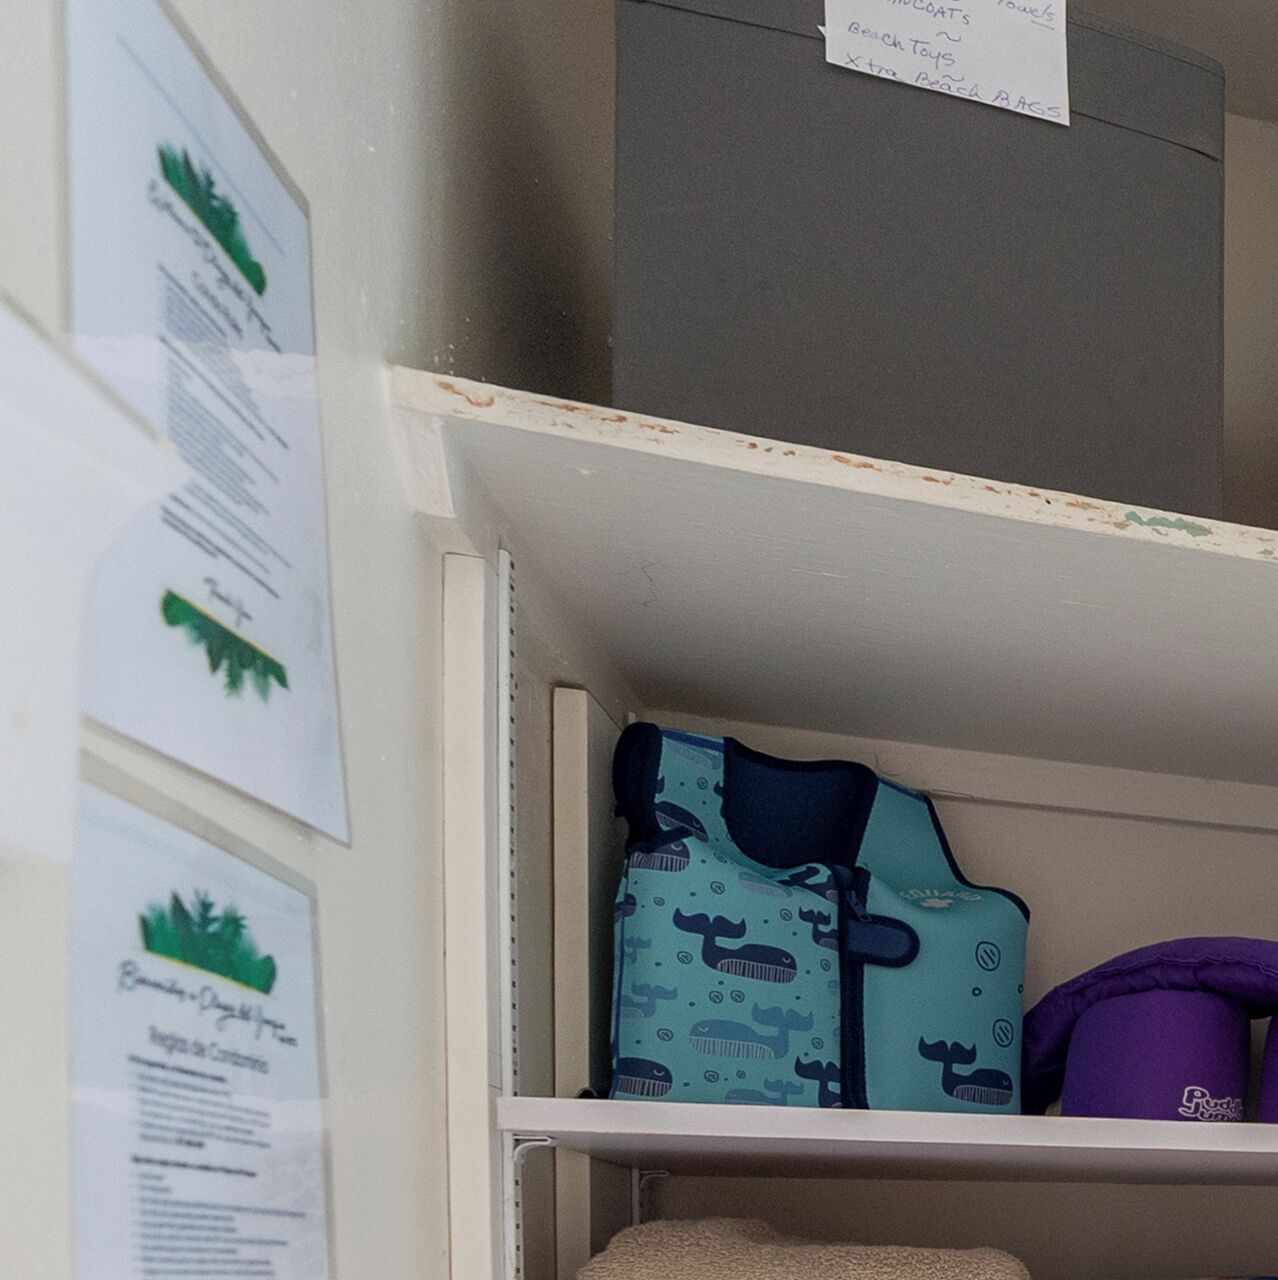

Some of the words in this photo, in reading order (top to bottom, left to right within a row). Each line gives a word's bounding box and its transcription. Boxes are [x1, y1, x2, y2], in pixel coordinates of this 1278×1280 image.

[886, 0, 970, 26] COATS
[998, 0, 1056, 22] owels
[847, 21, 905, 52] Beach
[908, 38, 956, 70] Toys
[914, 71, 983, 100] Beach
[991, 89, 1062, 119] BAGS
